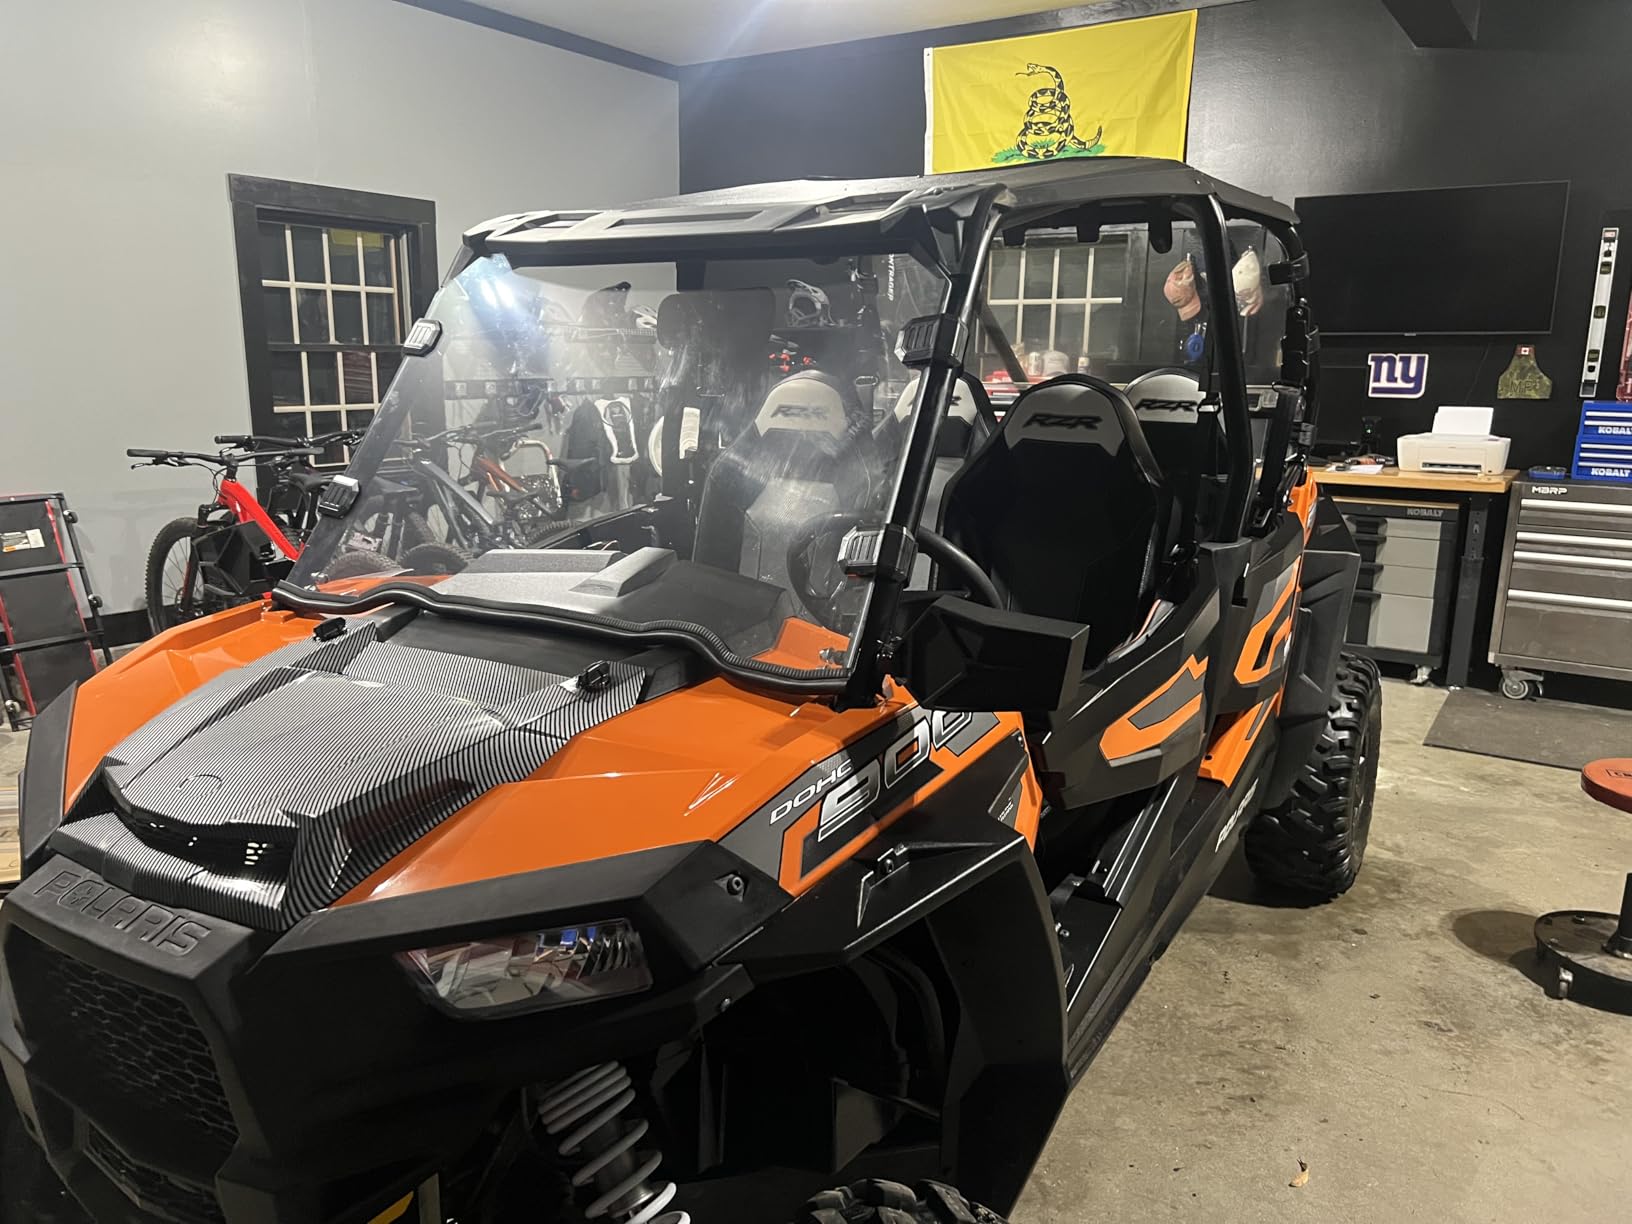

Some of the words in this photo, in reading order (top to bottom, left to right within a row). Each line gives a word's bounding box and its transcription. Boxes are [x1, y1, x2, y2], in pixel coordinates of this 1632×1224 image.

[1136, 398, 1198, 413] RZR
[1022, 413, 1103, 430] RZR
[1597, 426, 1632, 436] KOBAL
[1590, 467, 1631, 478] KOBALT
[1407, 507, 1443, 518] KOBALT
[769, 758, 853, 826] DOHC
[32, 869, 213, 958] POLARIS
